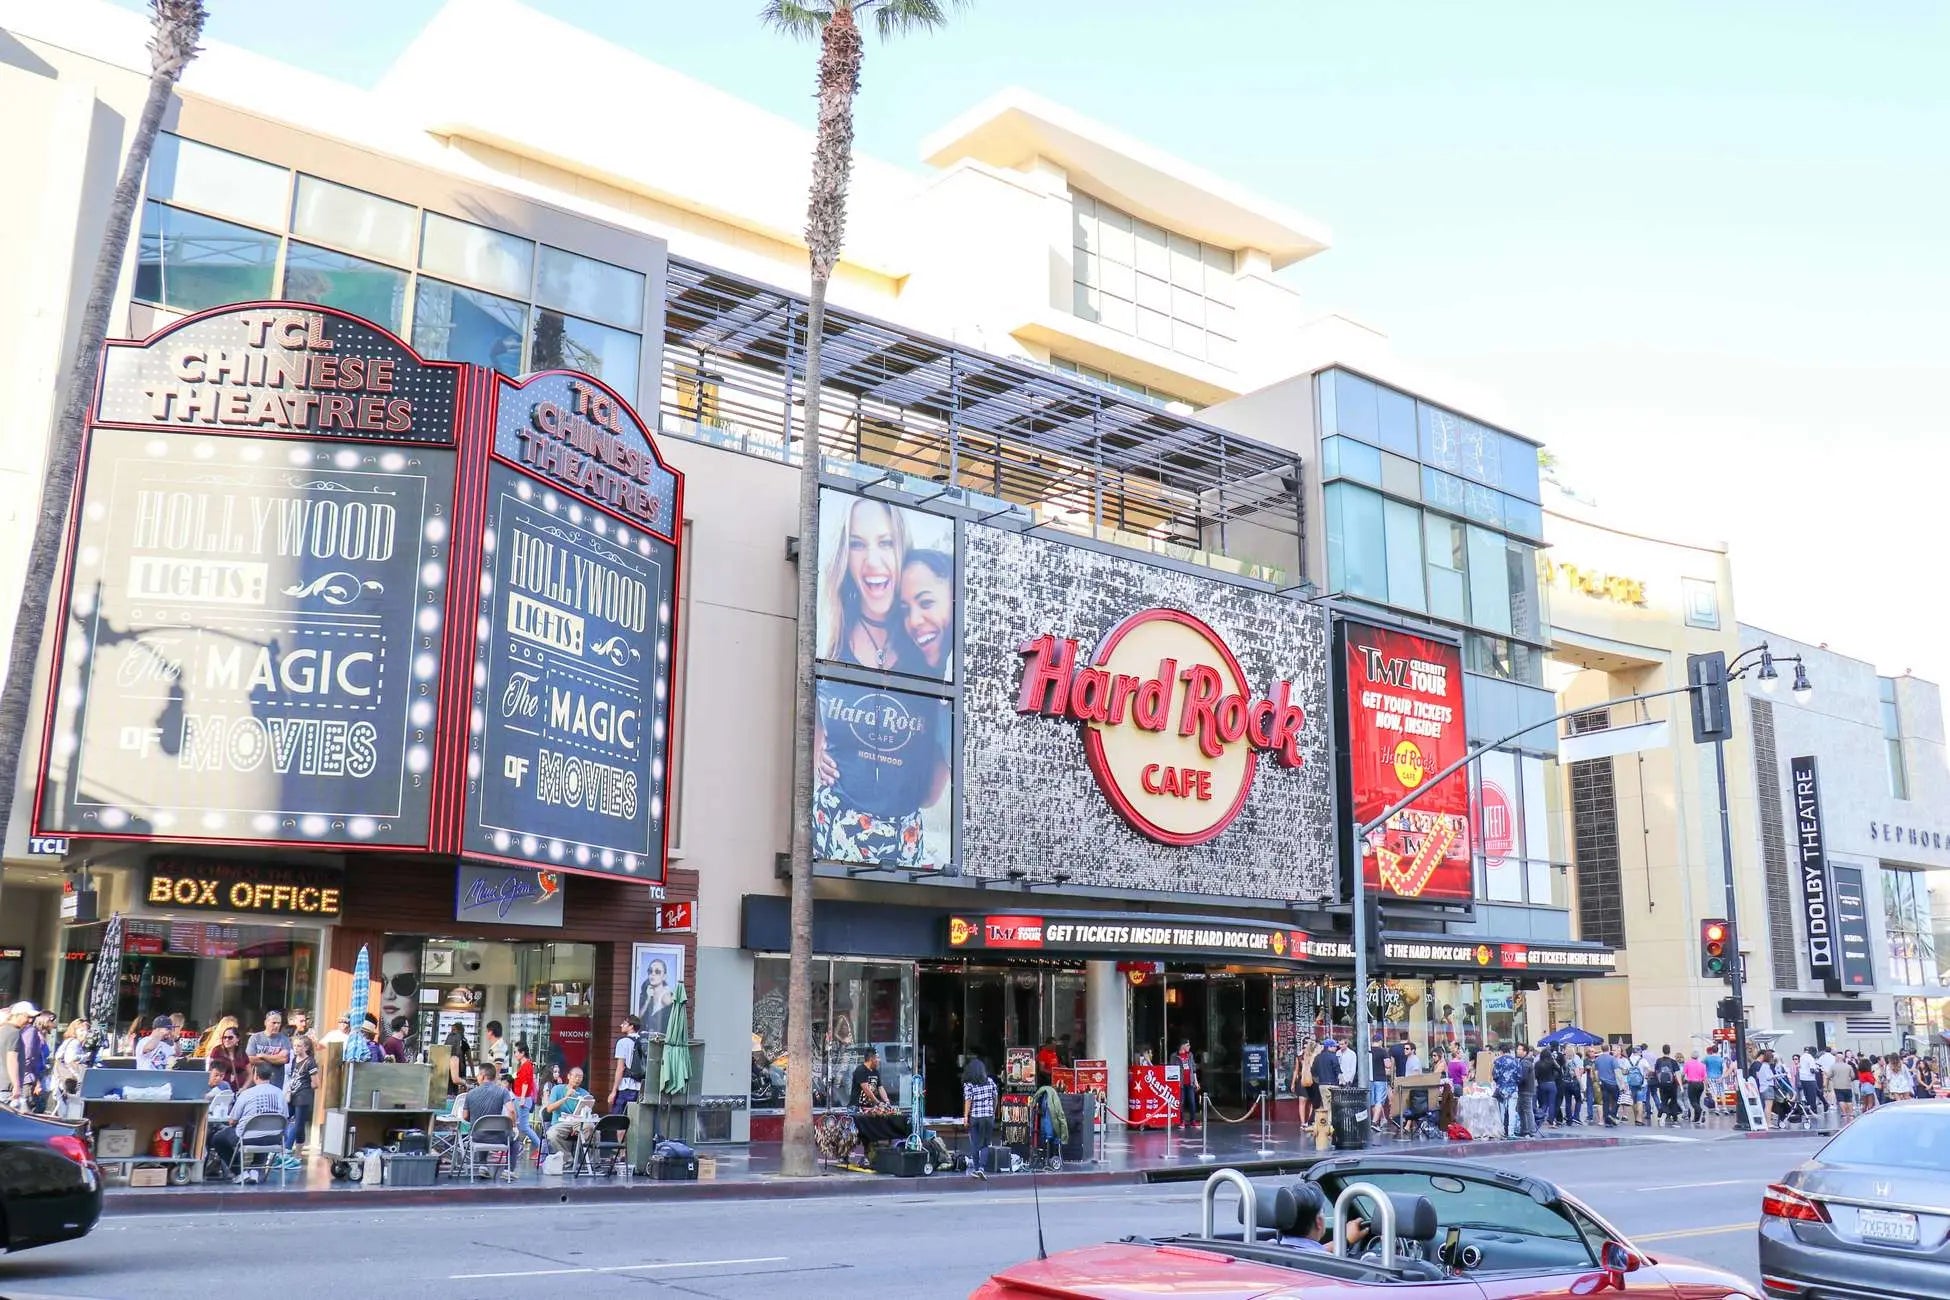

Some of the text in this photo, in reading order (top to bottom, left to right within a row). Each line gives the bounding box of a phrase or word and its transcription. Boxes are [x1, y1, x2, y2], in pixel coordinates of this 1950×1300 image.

[241, 312, 334, 352] TCL
[169, 352, 396, 394] CHINESE
[145, 389, 412, 434] THEATRES
[571, 380, 622, 436] TCL
[532, 401, 652, 486] CHINESE
[516, 428, 661, 524] THEATRES
[133, 489, 396, 563] HOLLYWOOD
[139, 560, 264, 601] LIGHTS:
[510, 528, 647, 633] HOLLYWOOD
[516, 602, 582, 650] LIGHTS:
[117, 639, 375, 697] The MAGIC
[1358, 645, 1446, 689] TMZ CELEBRITY
[1410, 671, 1446, 697] TOUR
[503, 671, 636, 749] The MAGIC
[883, 707, 926, 733] Rock
[1016, 633, 1305, 768] Hard Rock
[1362, 690, 1453, 724] GET YOUR TICKETS
[868, 732, 894, 743] CAFE
[1375, 711, 1442, 739] NOW, INSIDE!
[119, 712, 378, 779] OF MOVIES
[1381, 745, 1438, 775] Hard Rock
[504, 748, 638, 820] OF MOVIES
[1142, 763, 1212, 800] CAFE
[30, 838, 67, 854] TCL
[1797, 768, 1827, 935] DOLBY THEATRE
[149, 876, 340, 913] BOX OFFICE
[650, 886, 665, 899] TCL
[986, 924, 1016, 941] TMZ
[1047, 925, 1075, 941] GET
[1076, 926, 1129, 943] TICKETS
[1130, 927, 1171, 945] INSIDE
[1173, 929, 1194, 945] THE
[1194, 930, 1224, 947] HARD
[1224, 931, 1249, 948] ROCK
[1249, 932, 1268, 949] CAFE
[1394, 944, 1408, 958] THE
[1409, 945, 1431, 959] HARD
[1431, 946, 1453, 960] ROCK
[1453, 947, 1472, 961] CAFE
[1528, 951, 1541, 964] GET
[1541, 952, 1566, 964] TICKETS
[559, 1030, 584, 1038] NIXON
[1144, 1069, 1180, 1108] Starline
